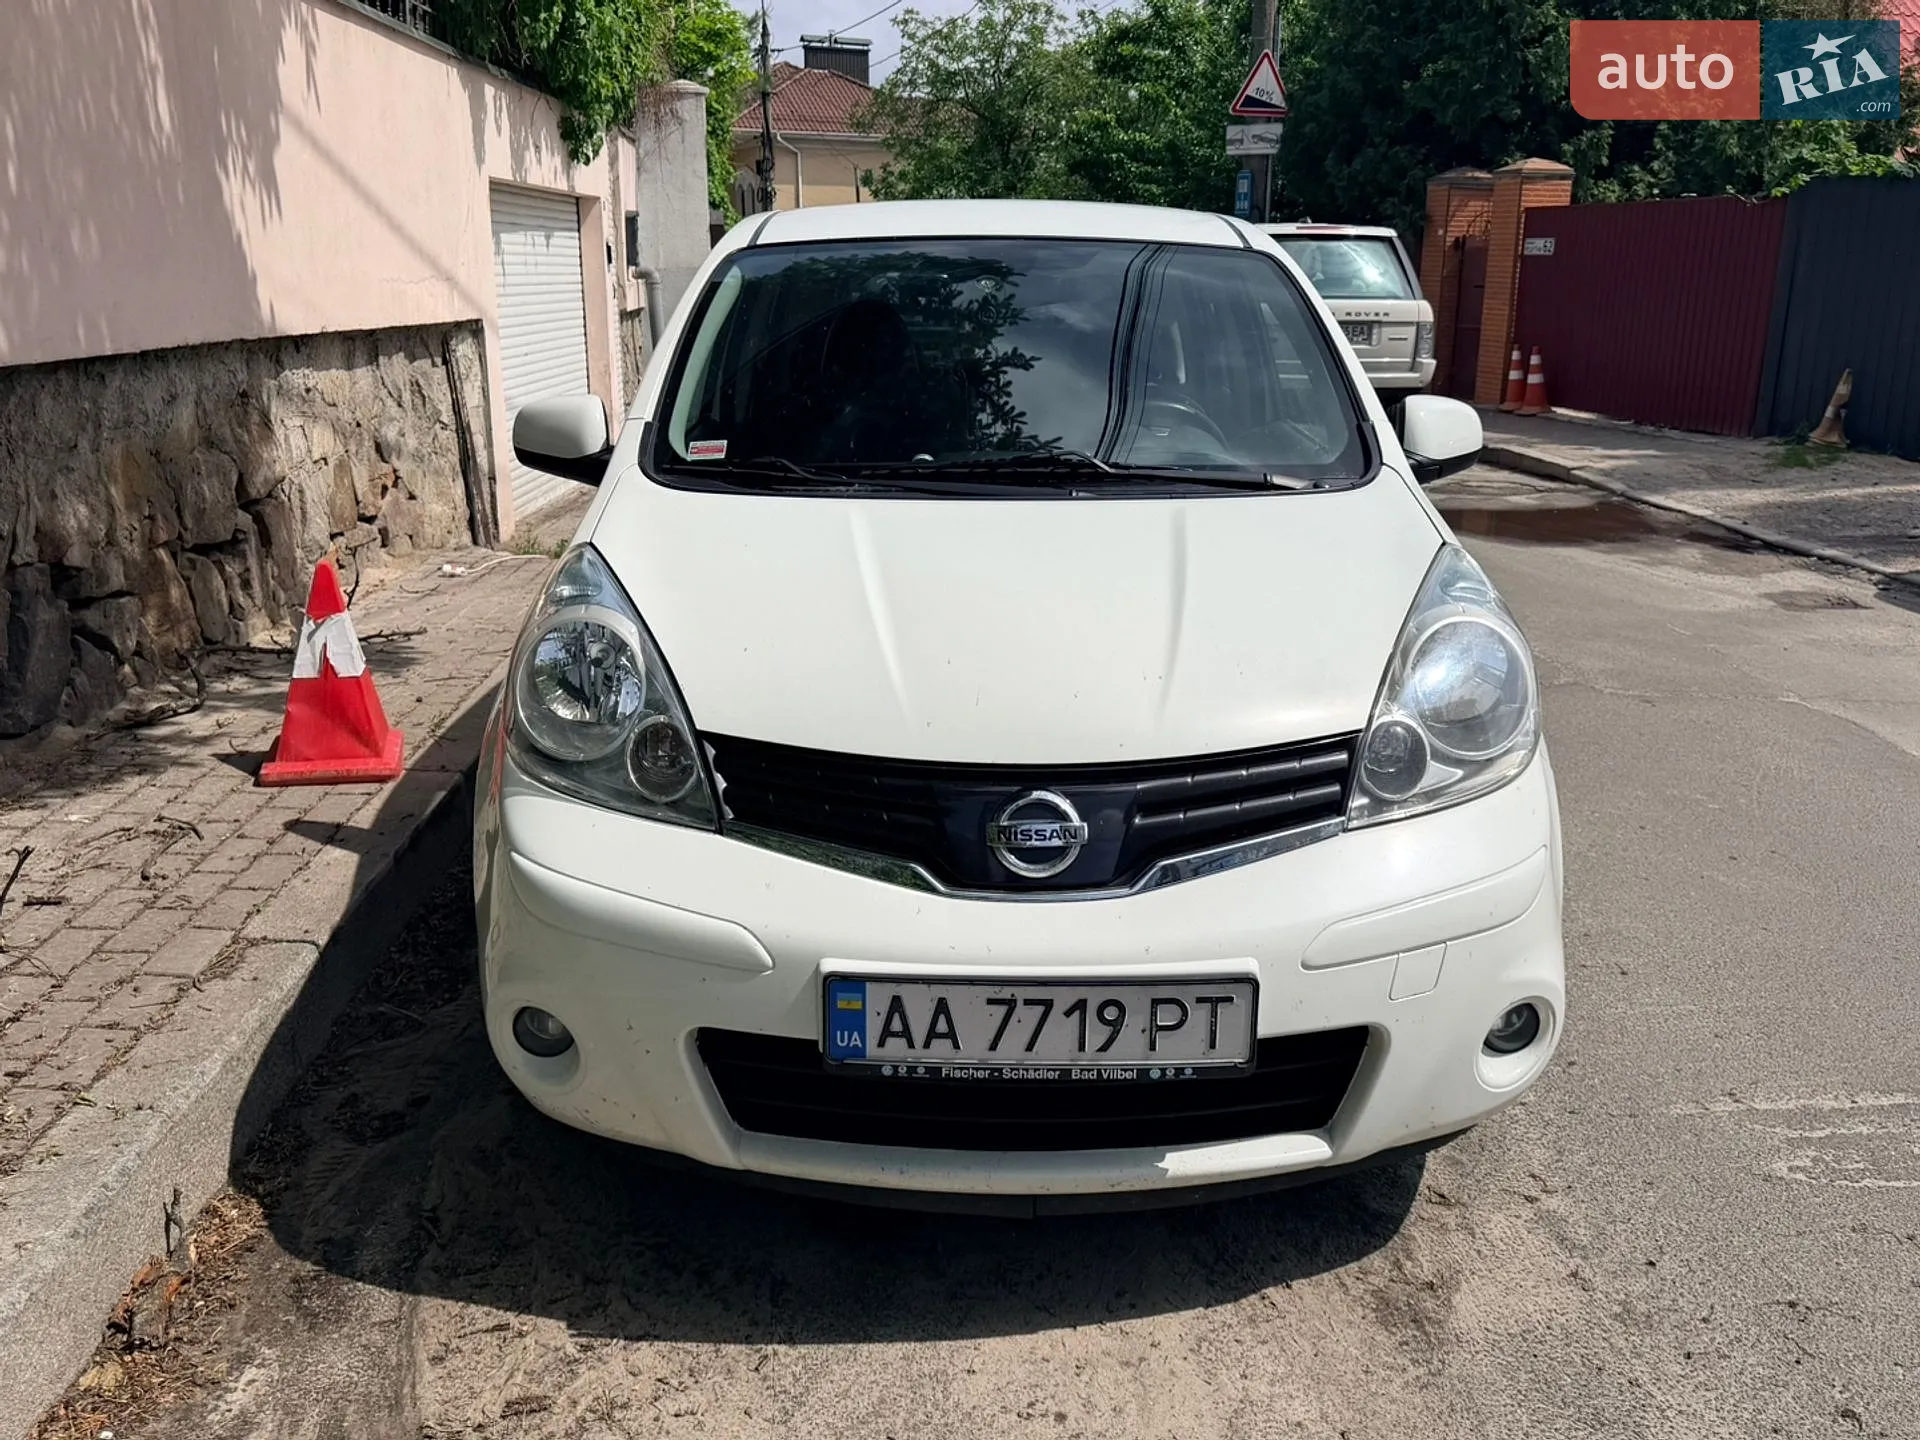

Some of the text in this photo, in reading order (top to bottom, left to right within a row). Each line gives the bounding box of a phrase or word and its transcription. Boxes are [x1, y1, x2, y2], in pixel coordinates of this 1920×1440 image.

[997, 828, 1078, 842] NISSAN
[877, 994, 1236, 1052] AA 7719 PT
[836, 1030, 863, 1048] UA
[941, 1067, 991, 1079] Fischer
[1071, 1068, 1098, 1080] Bad
[1100, 1068, 1137, 1080] Vilbel
